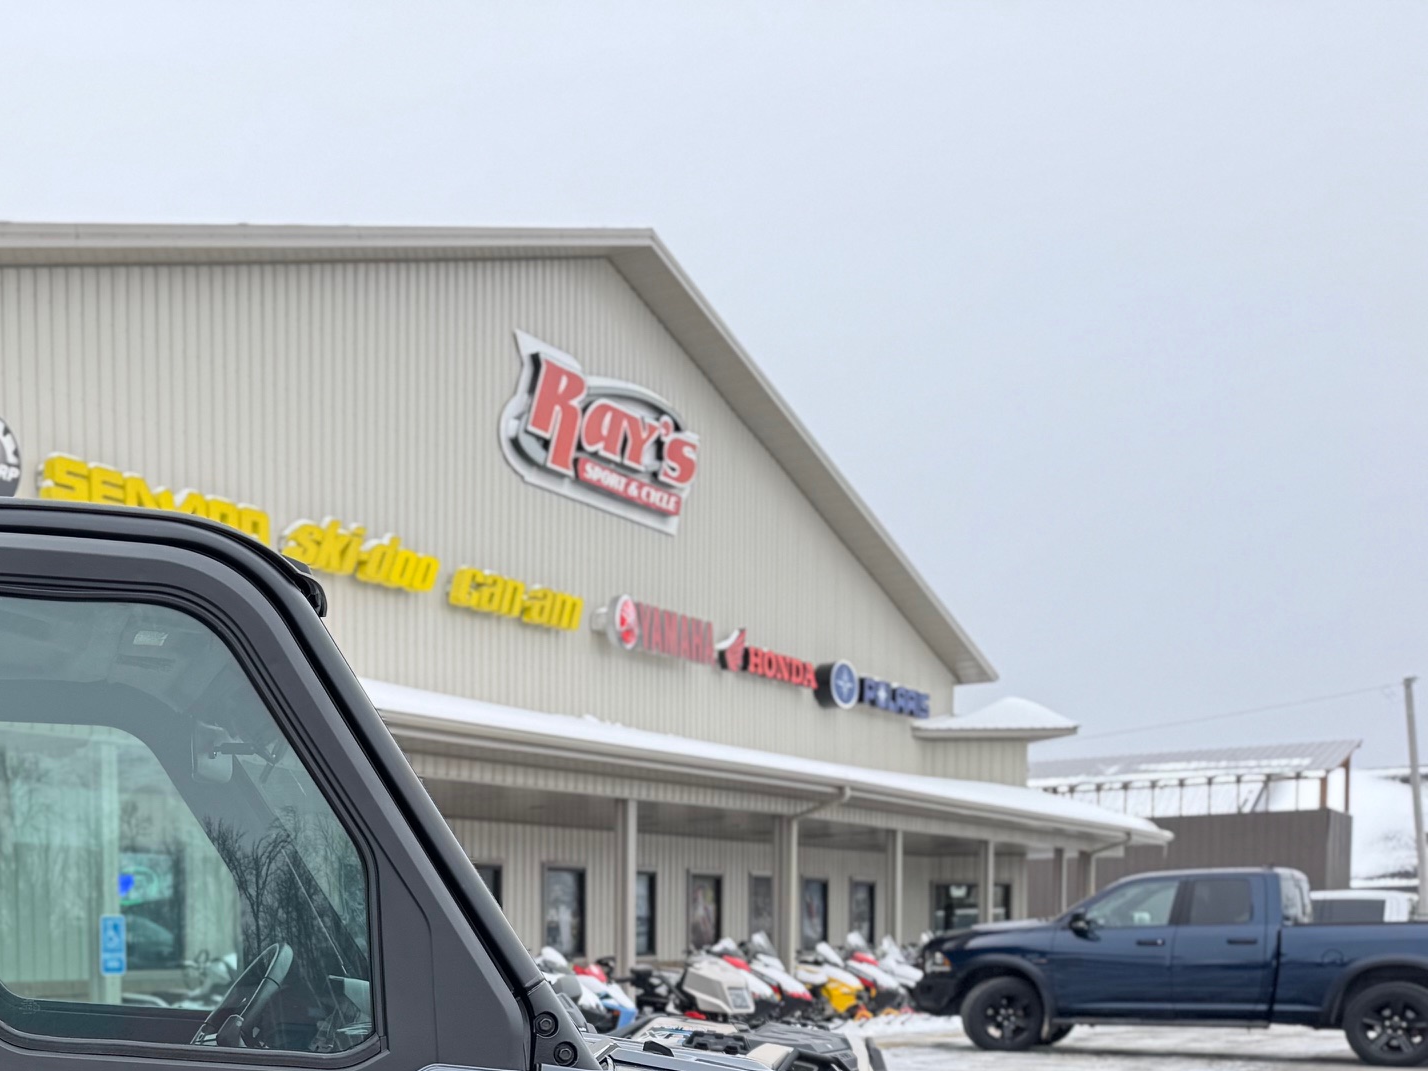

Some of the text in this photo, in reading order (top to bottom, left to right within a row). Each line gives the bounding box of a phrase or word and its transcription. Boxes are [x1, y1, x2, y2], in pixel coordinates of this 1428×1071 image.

[584, 461, 679, 513] SPORT & CYCLE
[637, 602, 716, 666] YAMAHA
[745, 646, 818, 690] HONDA
